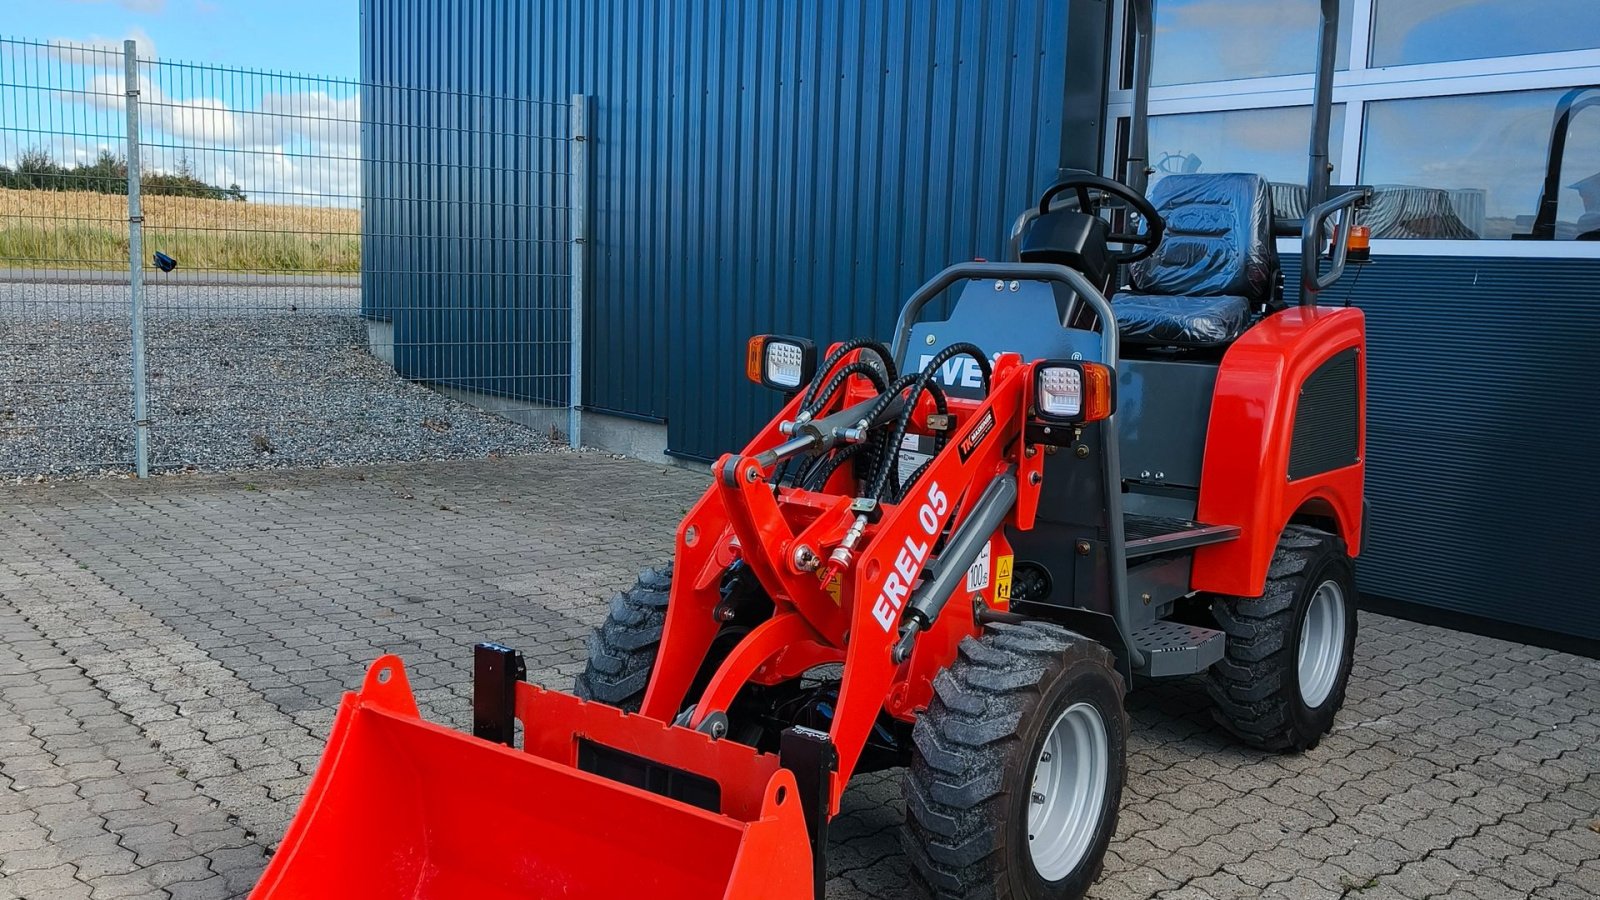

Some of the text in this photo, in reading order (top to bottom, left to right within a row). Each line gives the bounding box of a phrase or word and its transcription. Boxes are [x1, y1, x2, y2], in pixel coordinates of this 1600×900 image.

[872, 481, 948, 632] EREL 05
[970, 563, 983, 587] 100
